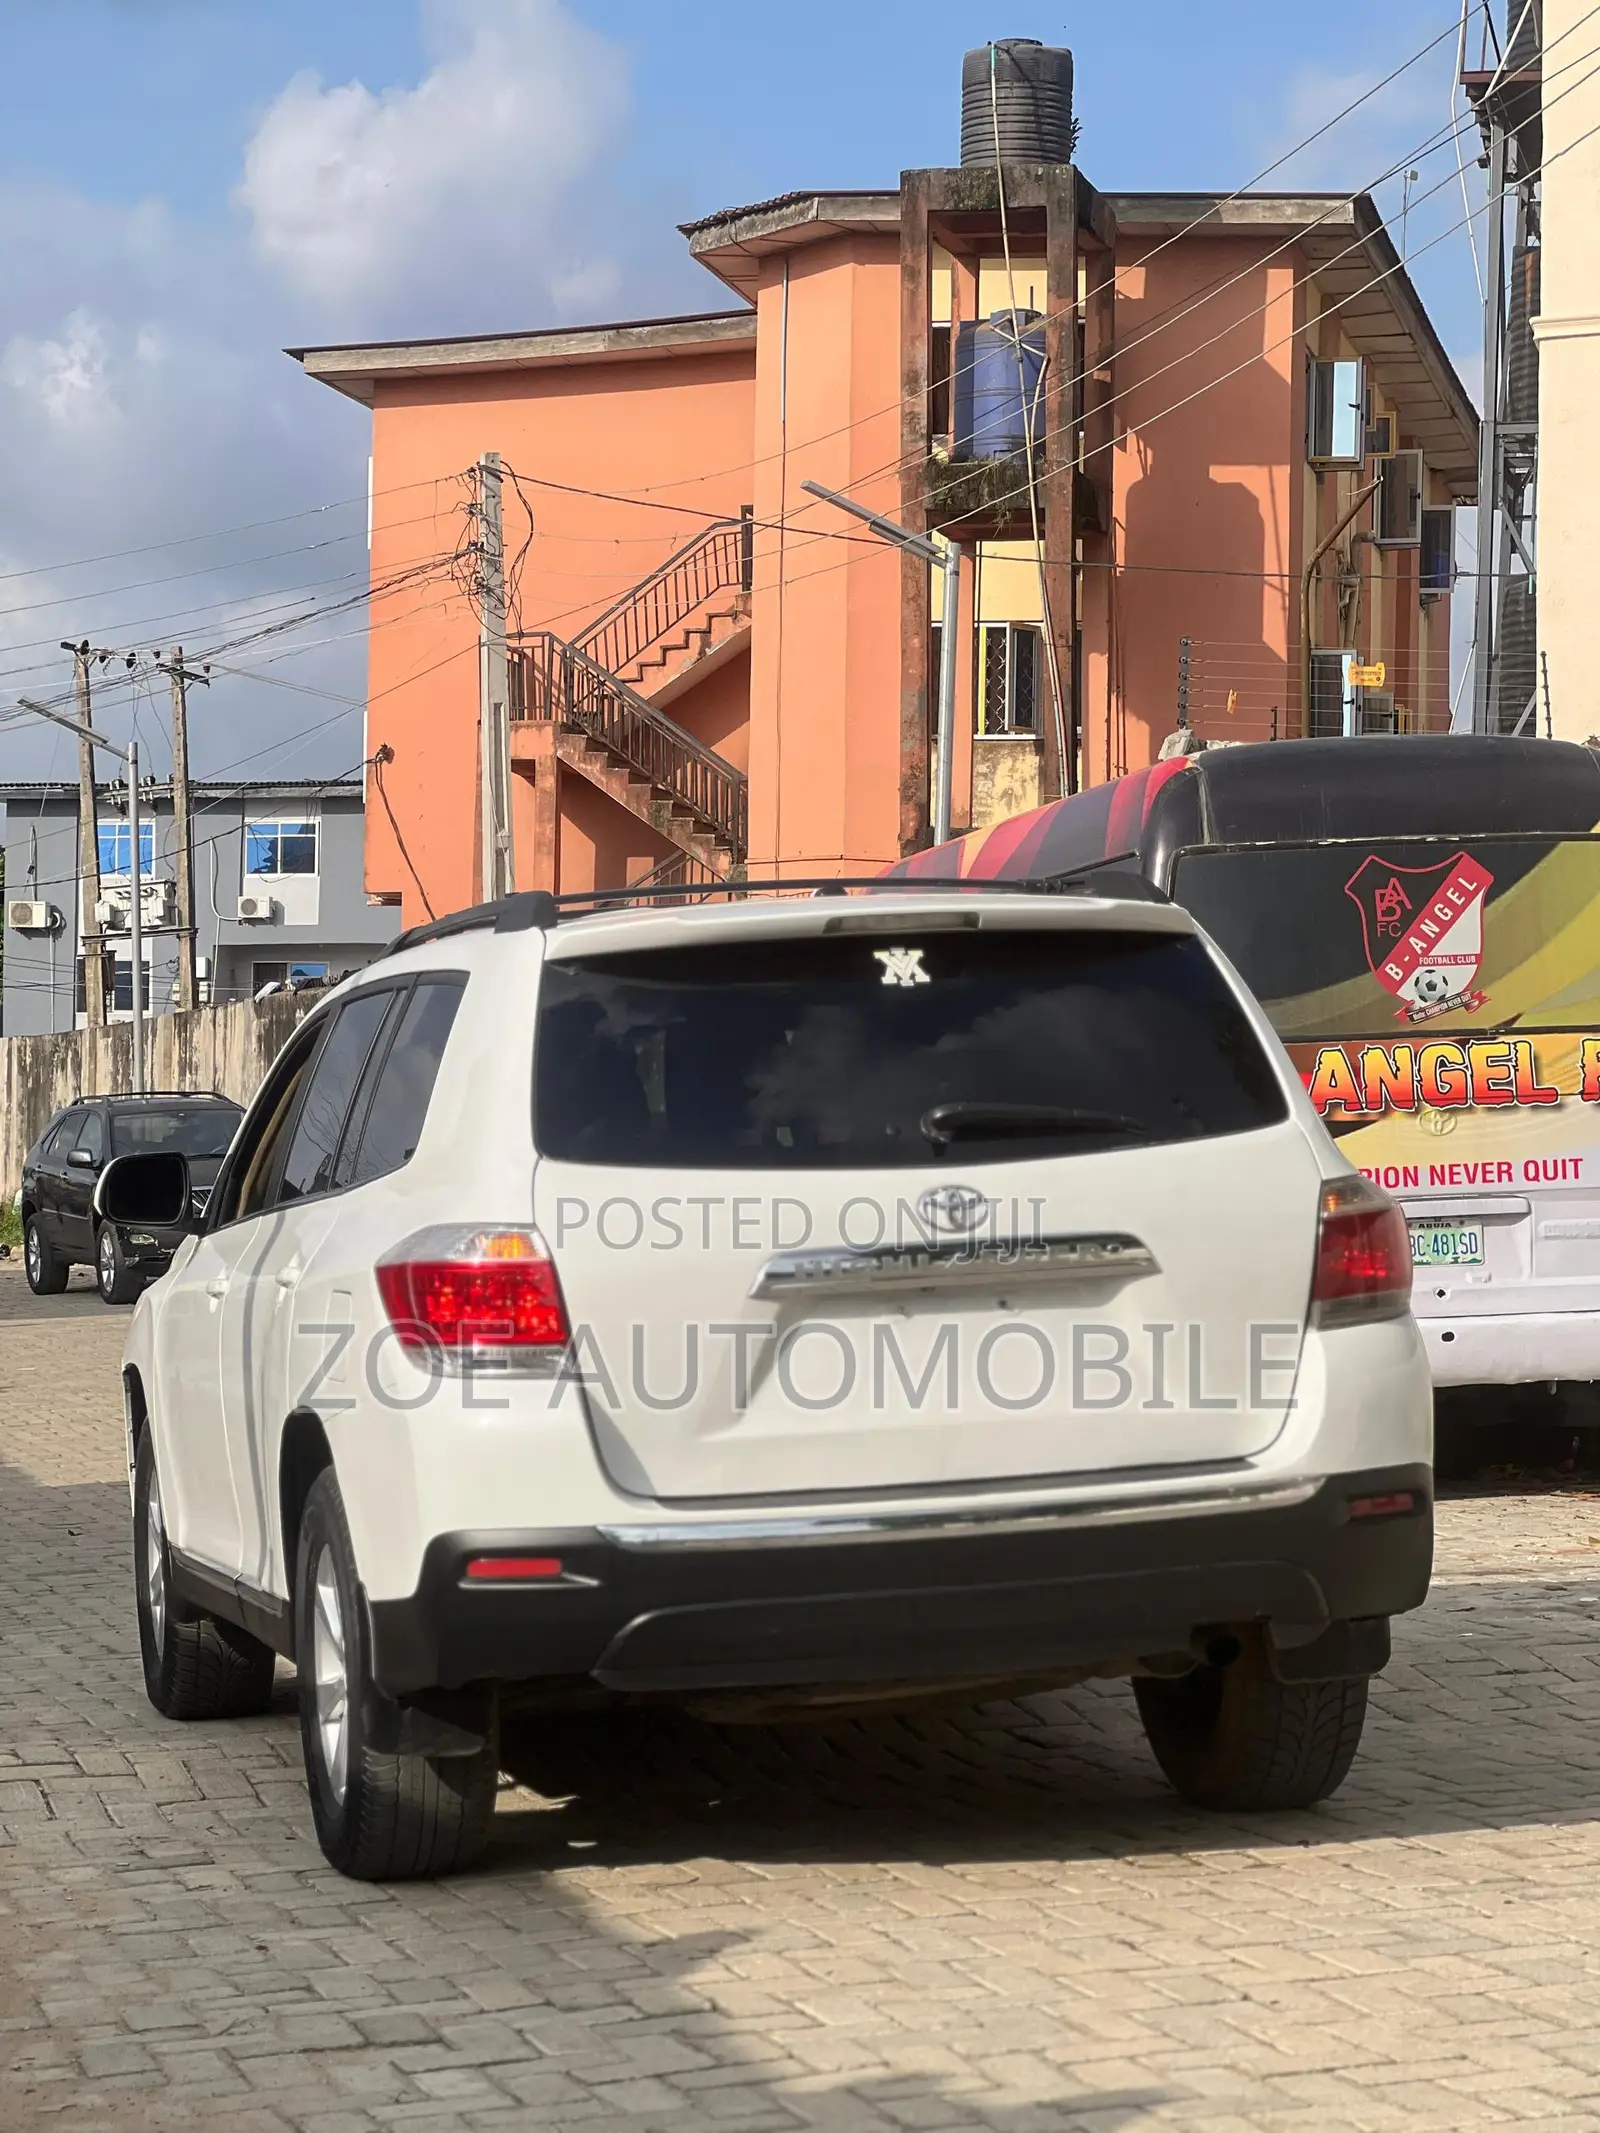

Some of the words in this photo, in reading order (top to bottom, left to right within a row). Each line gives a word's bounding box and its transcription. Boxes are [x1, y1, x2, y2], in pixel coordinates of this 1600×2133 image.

[1377, 922, 1402, 937] FC
[1419, 956, 1455, 965] FOOTBALL
[1457, 955, 1476, 964] CLUB
[1430, 1161, 1513, 1187] NEVER
[1524, 1158, 1584, 1182] QUIT
